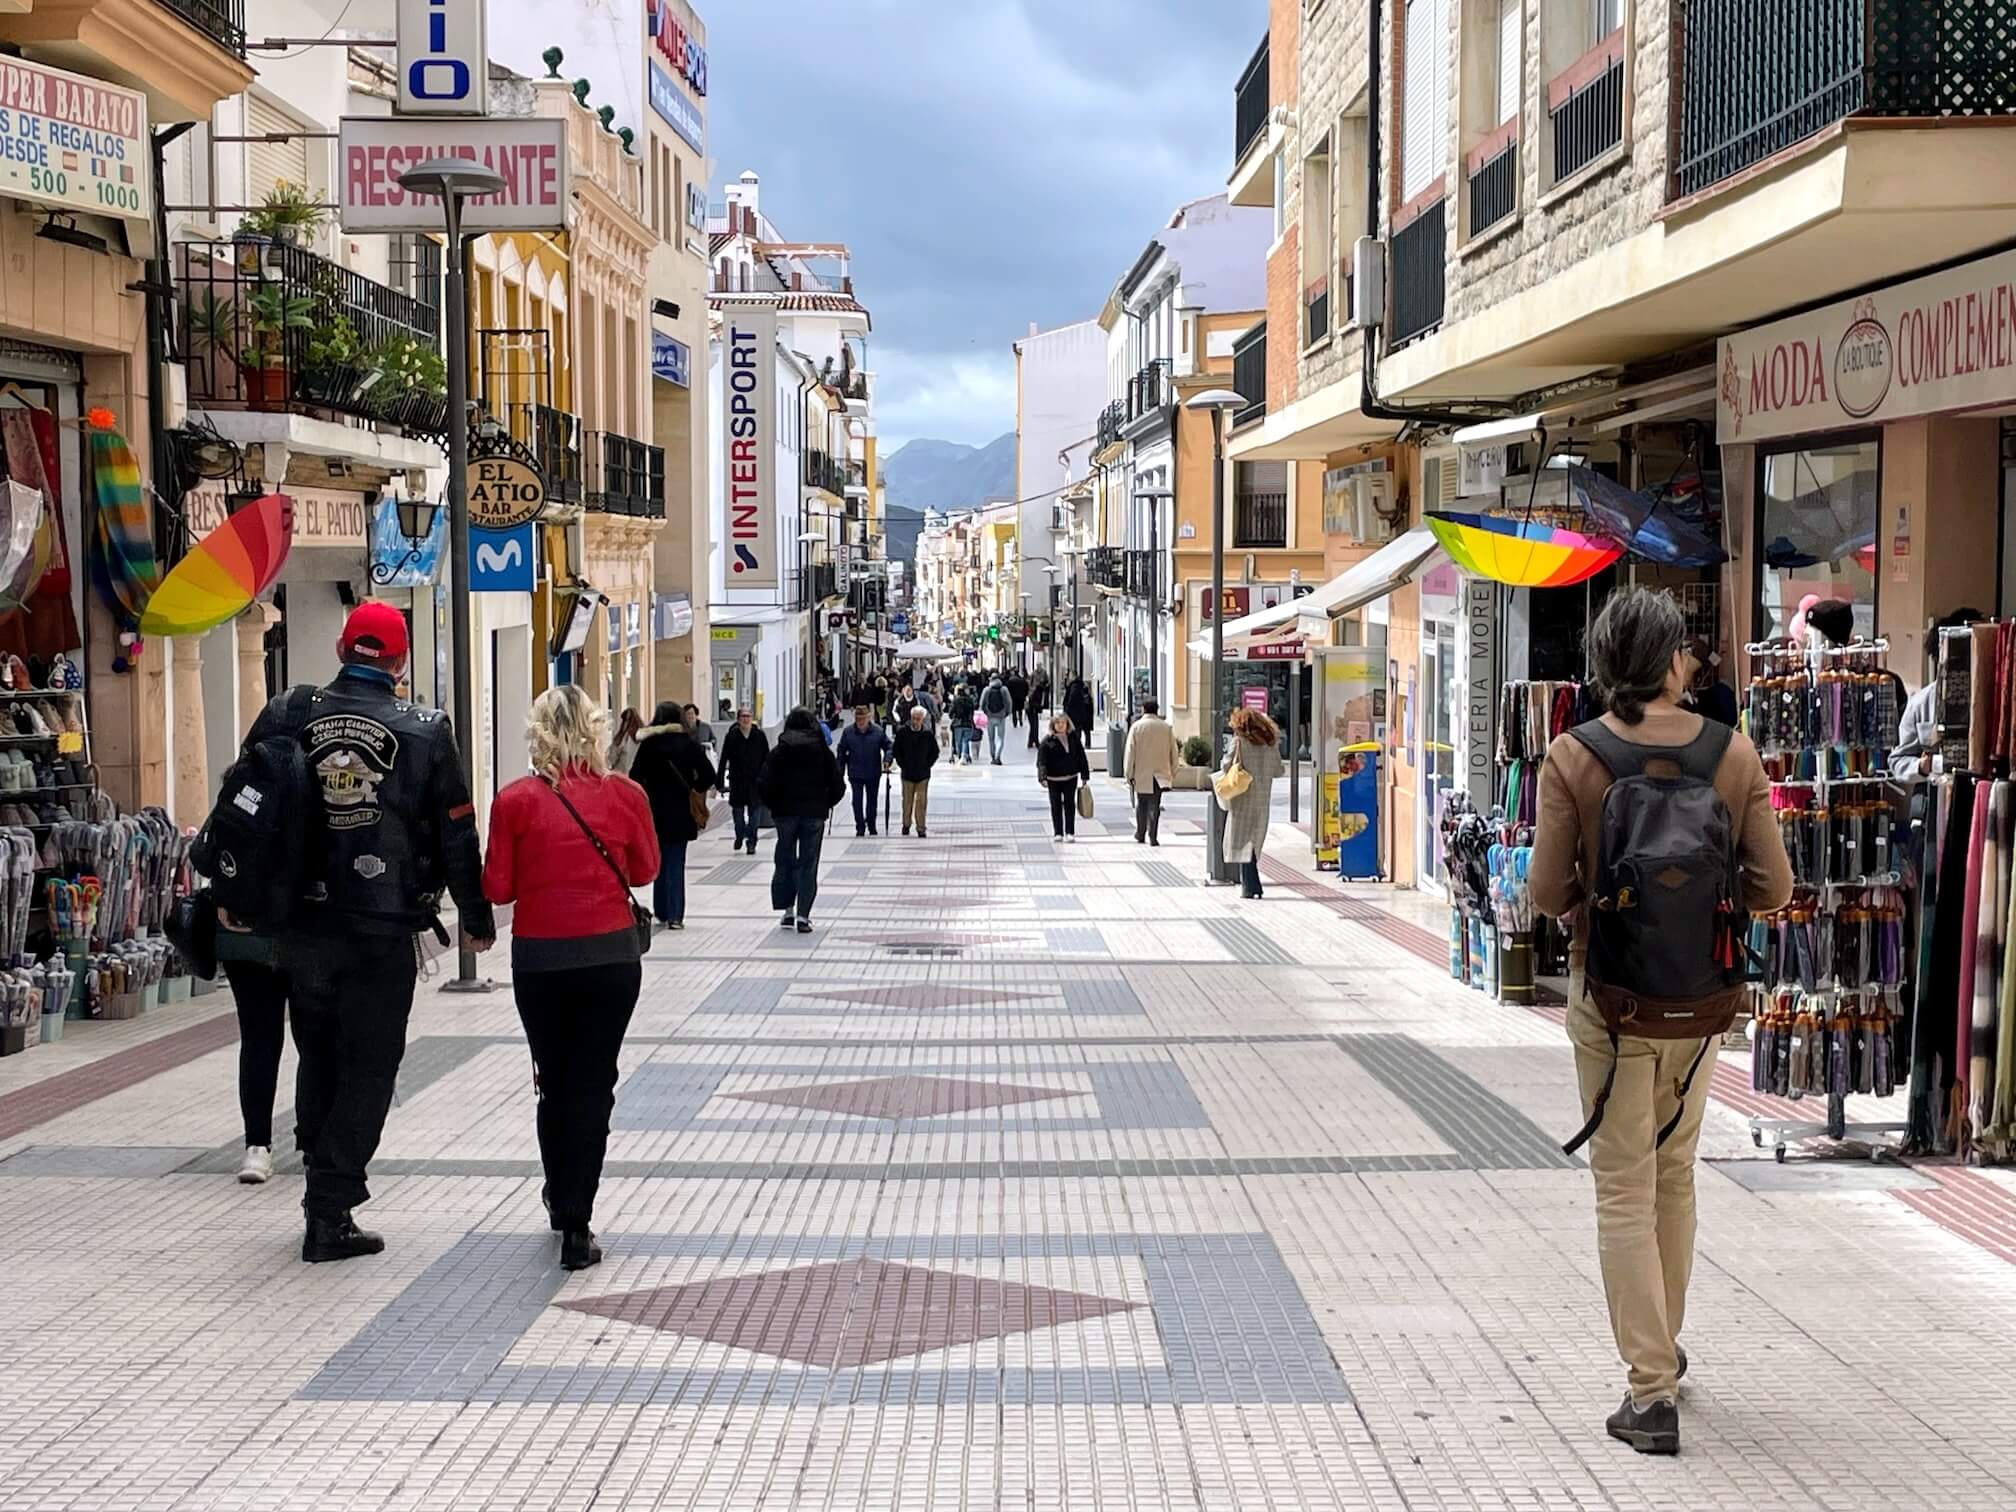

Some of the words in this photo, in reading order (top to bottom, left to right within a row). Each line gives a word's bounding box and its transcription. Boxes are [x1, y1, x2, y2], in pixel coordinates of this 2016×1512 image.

[56, 79, 133, 138] BARATO
[19, 113, 41, 140] DE
[50, 121, 125, 160] REGALOS
[31, 167, 67, 195] 500
[97, 181, 139, 211] 1000
[347, 145, 557, 206] RESTANTE
[1748, 336, 1828, 415] MODA
[731, 326, 759, 539] INTERSPORT
[469, 482, 540, 502] ATIO
[479, 463, 513, 482] EL
[306, 501, 323, 535] EL
[327, 501, 363, 537] PATIO
[481, 502, 512, 514] BAR
[1470, 678, 1489, 778] JOYERIA
